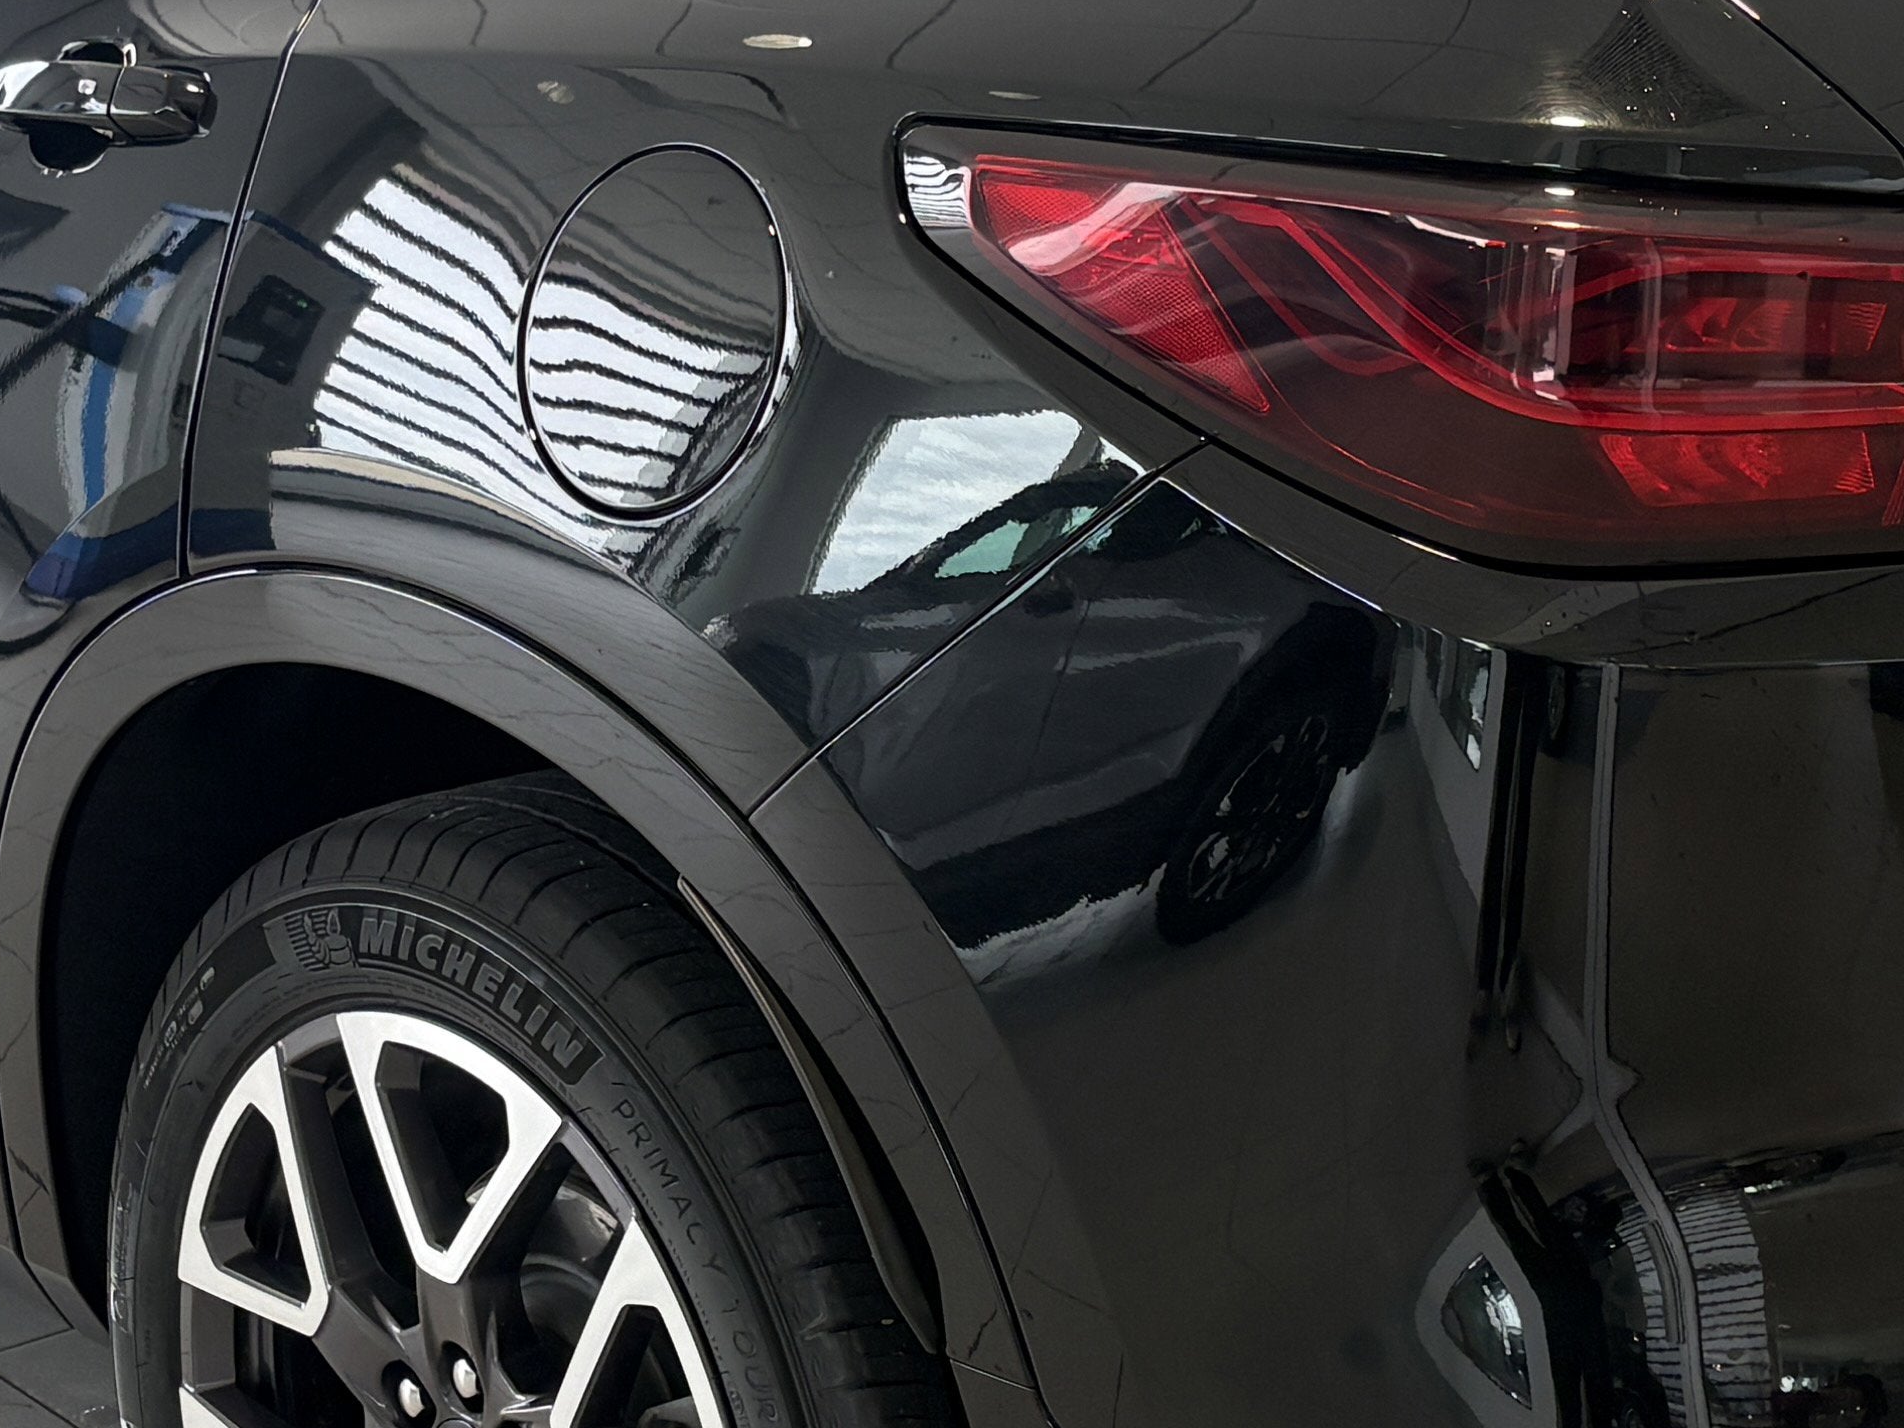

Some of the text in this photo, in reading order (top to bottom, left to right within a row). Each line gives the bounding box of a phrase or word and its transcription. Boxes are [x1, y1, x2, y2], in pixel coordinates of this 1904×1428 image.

[358, 916, 586, 1070] MICHELIN
[611, 1098, 728, 1278] PRIMACY
[719, 1297, 778, 1424] TOUR
